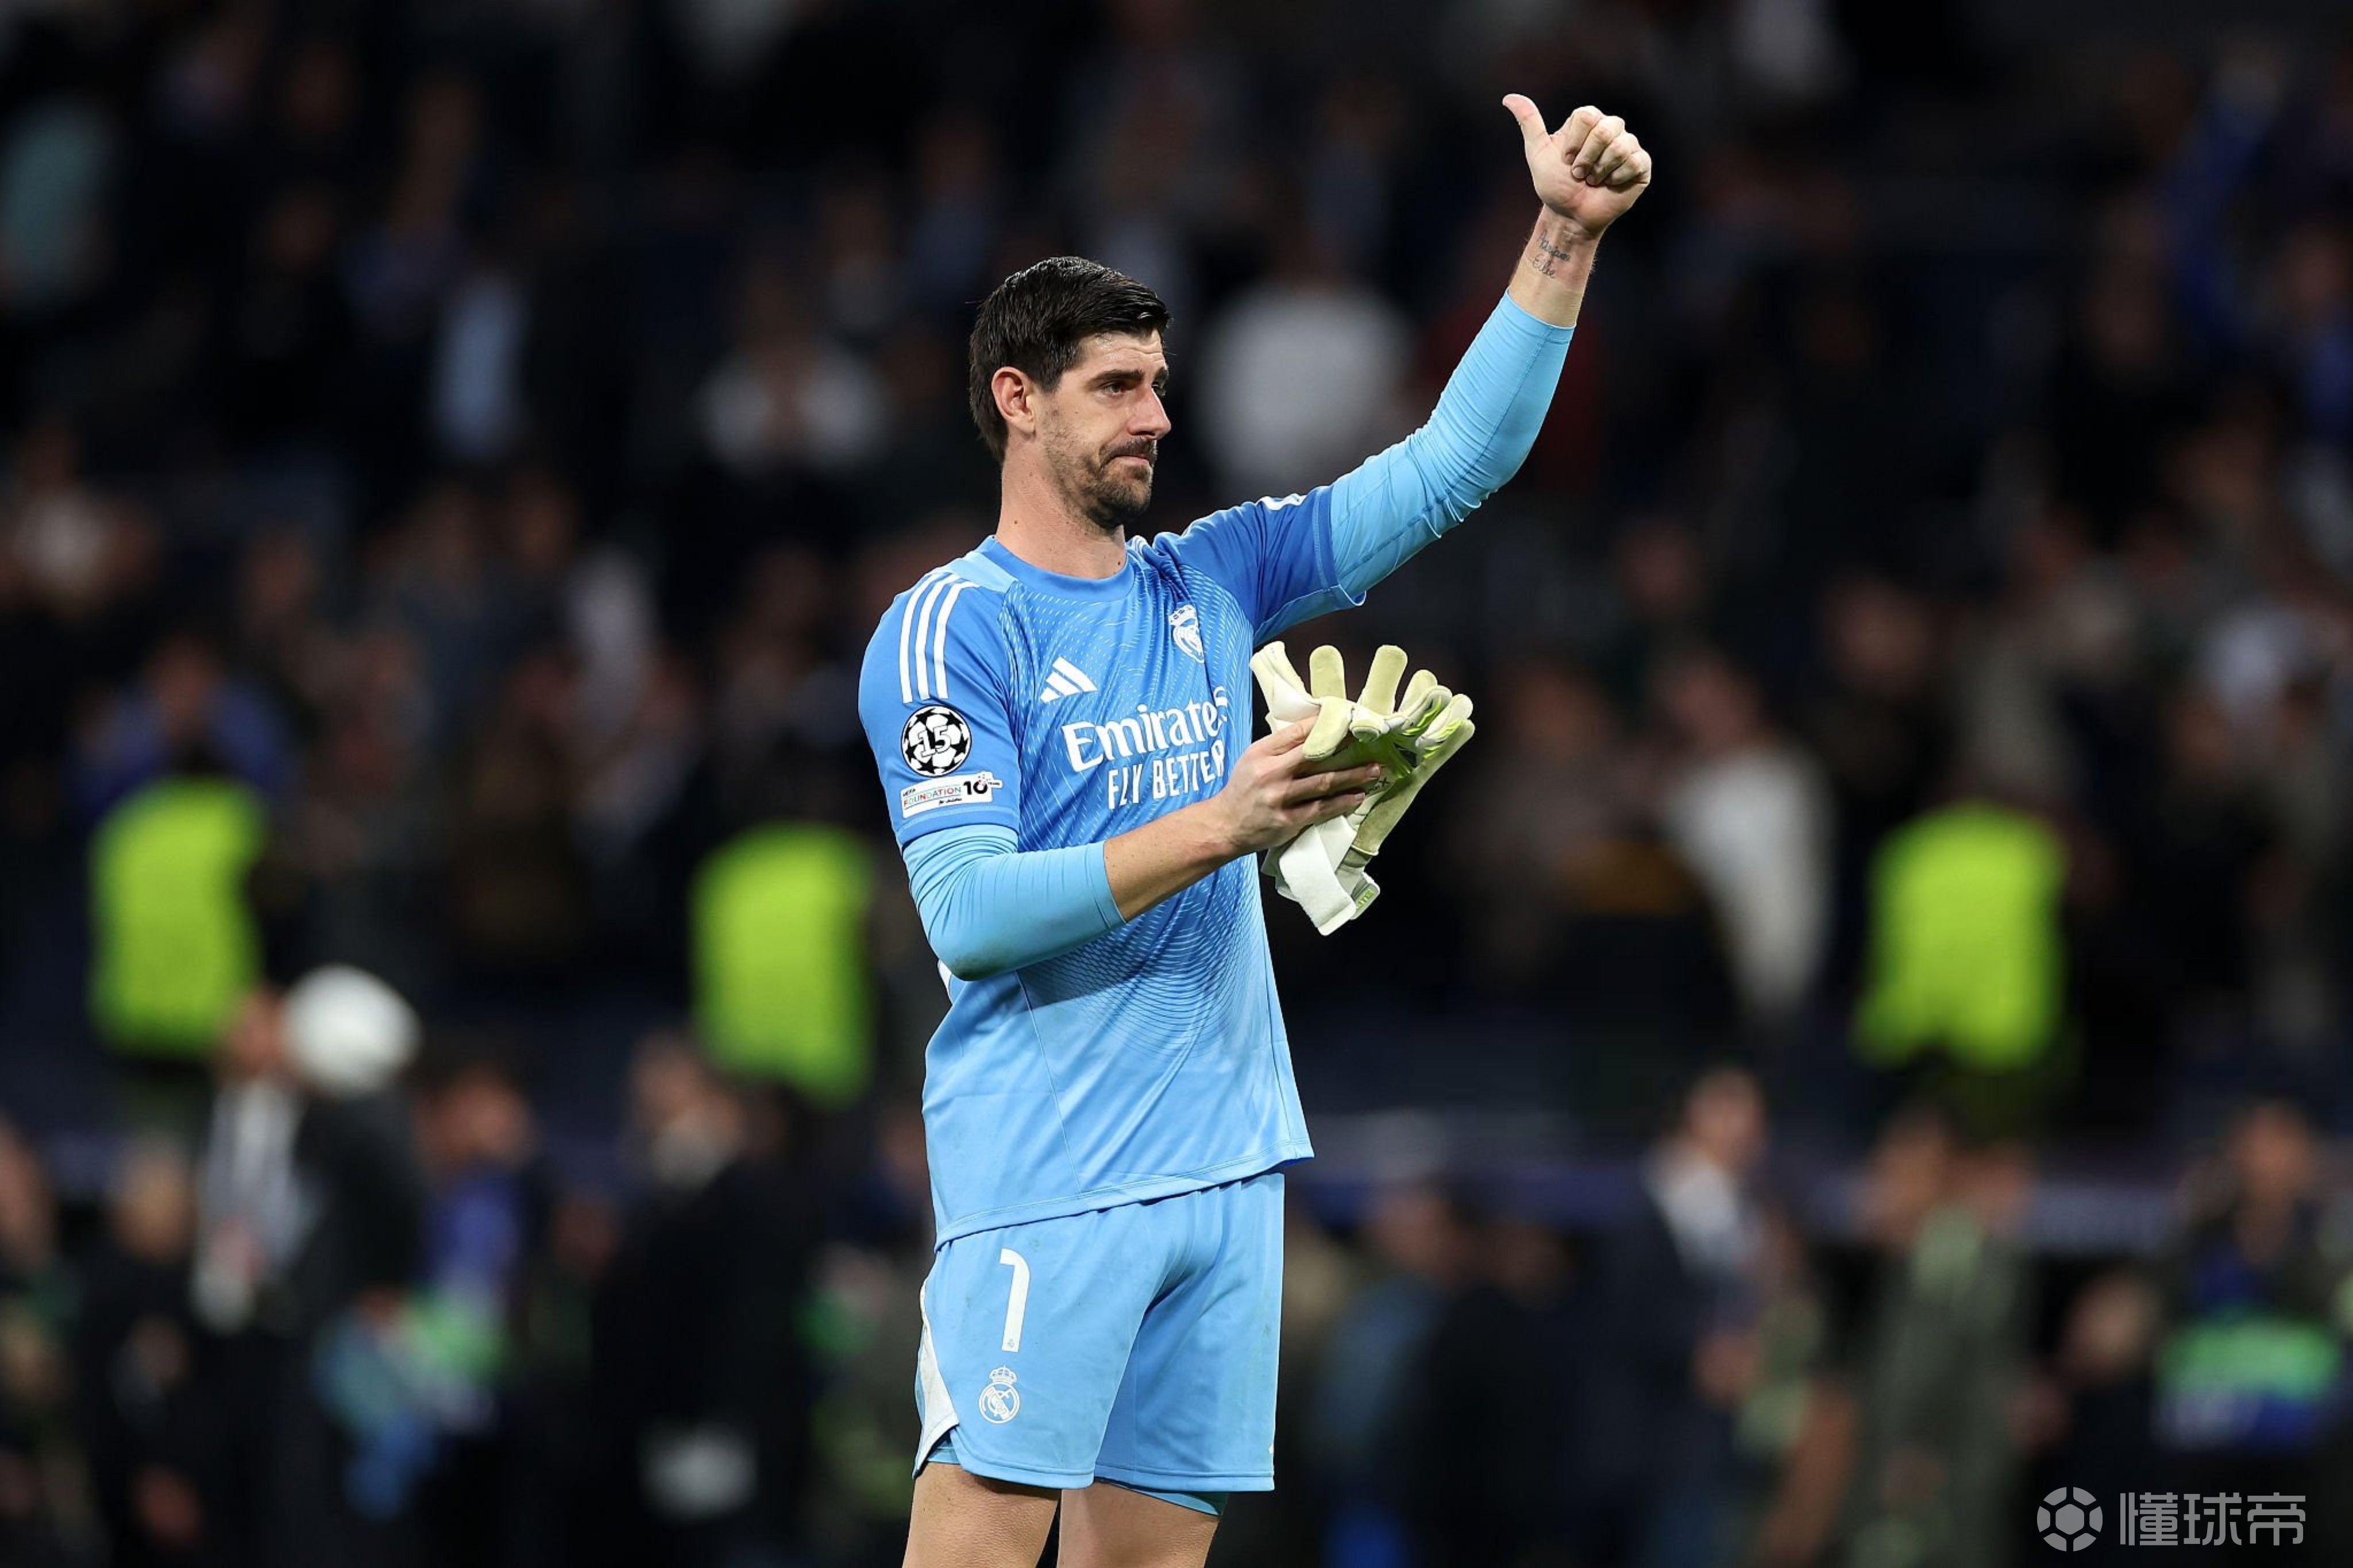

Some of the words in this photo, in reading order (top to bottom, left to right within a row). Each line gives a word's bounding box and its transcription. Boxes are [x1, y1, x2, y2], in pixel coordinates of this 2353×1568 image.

[918, 724, 951, 758] 15
[963, 780, 988, 795] 10
[1108, 764, 1143, 809] FLY
[1152, 739, 1225, 800] BETTER
[904, 787, 961, 806] FOUNDATION
[999, 1248, 1030, 1353] 1
